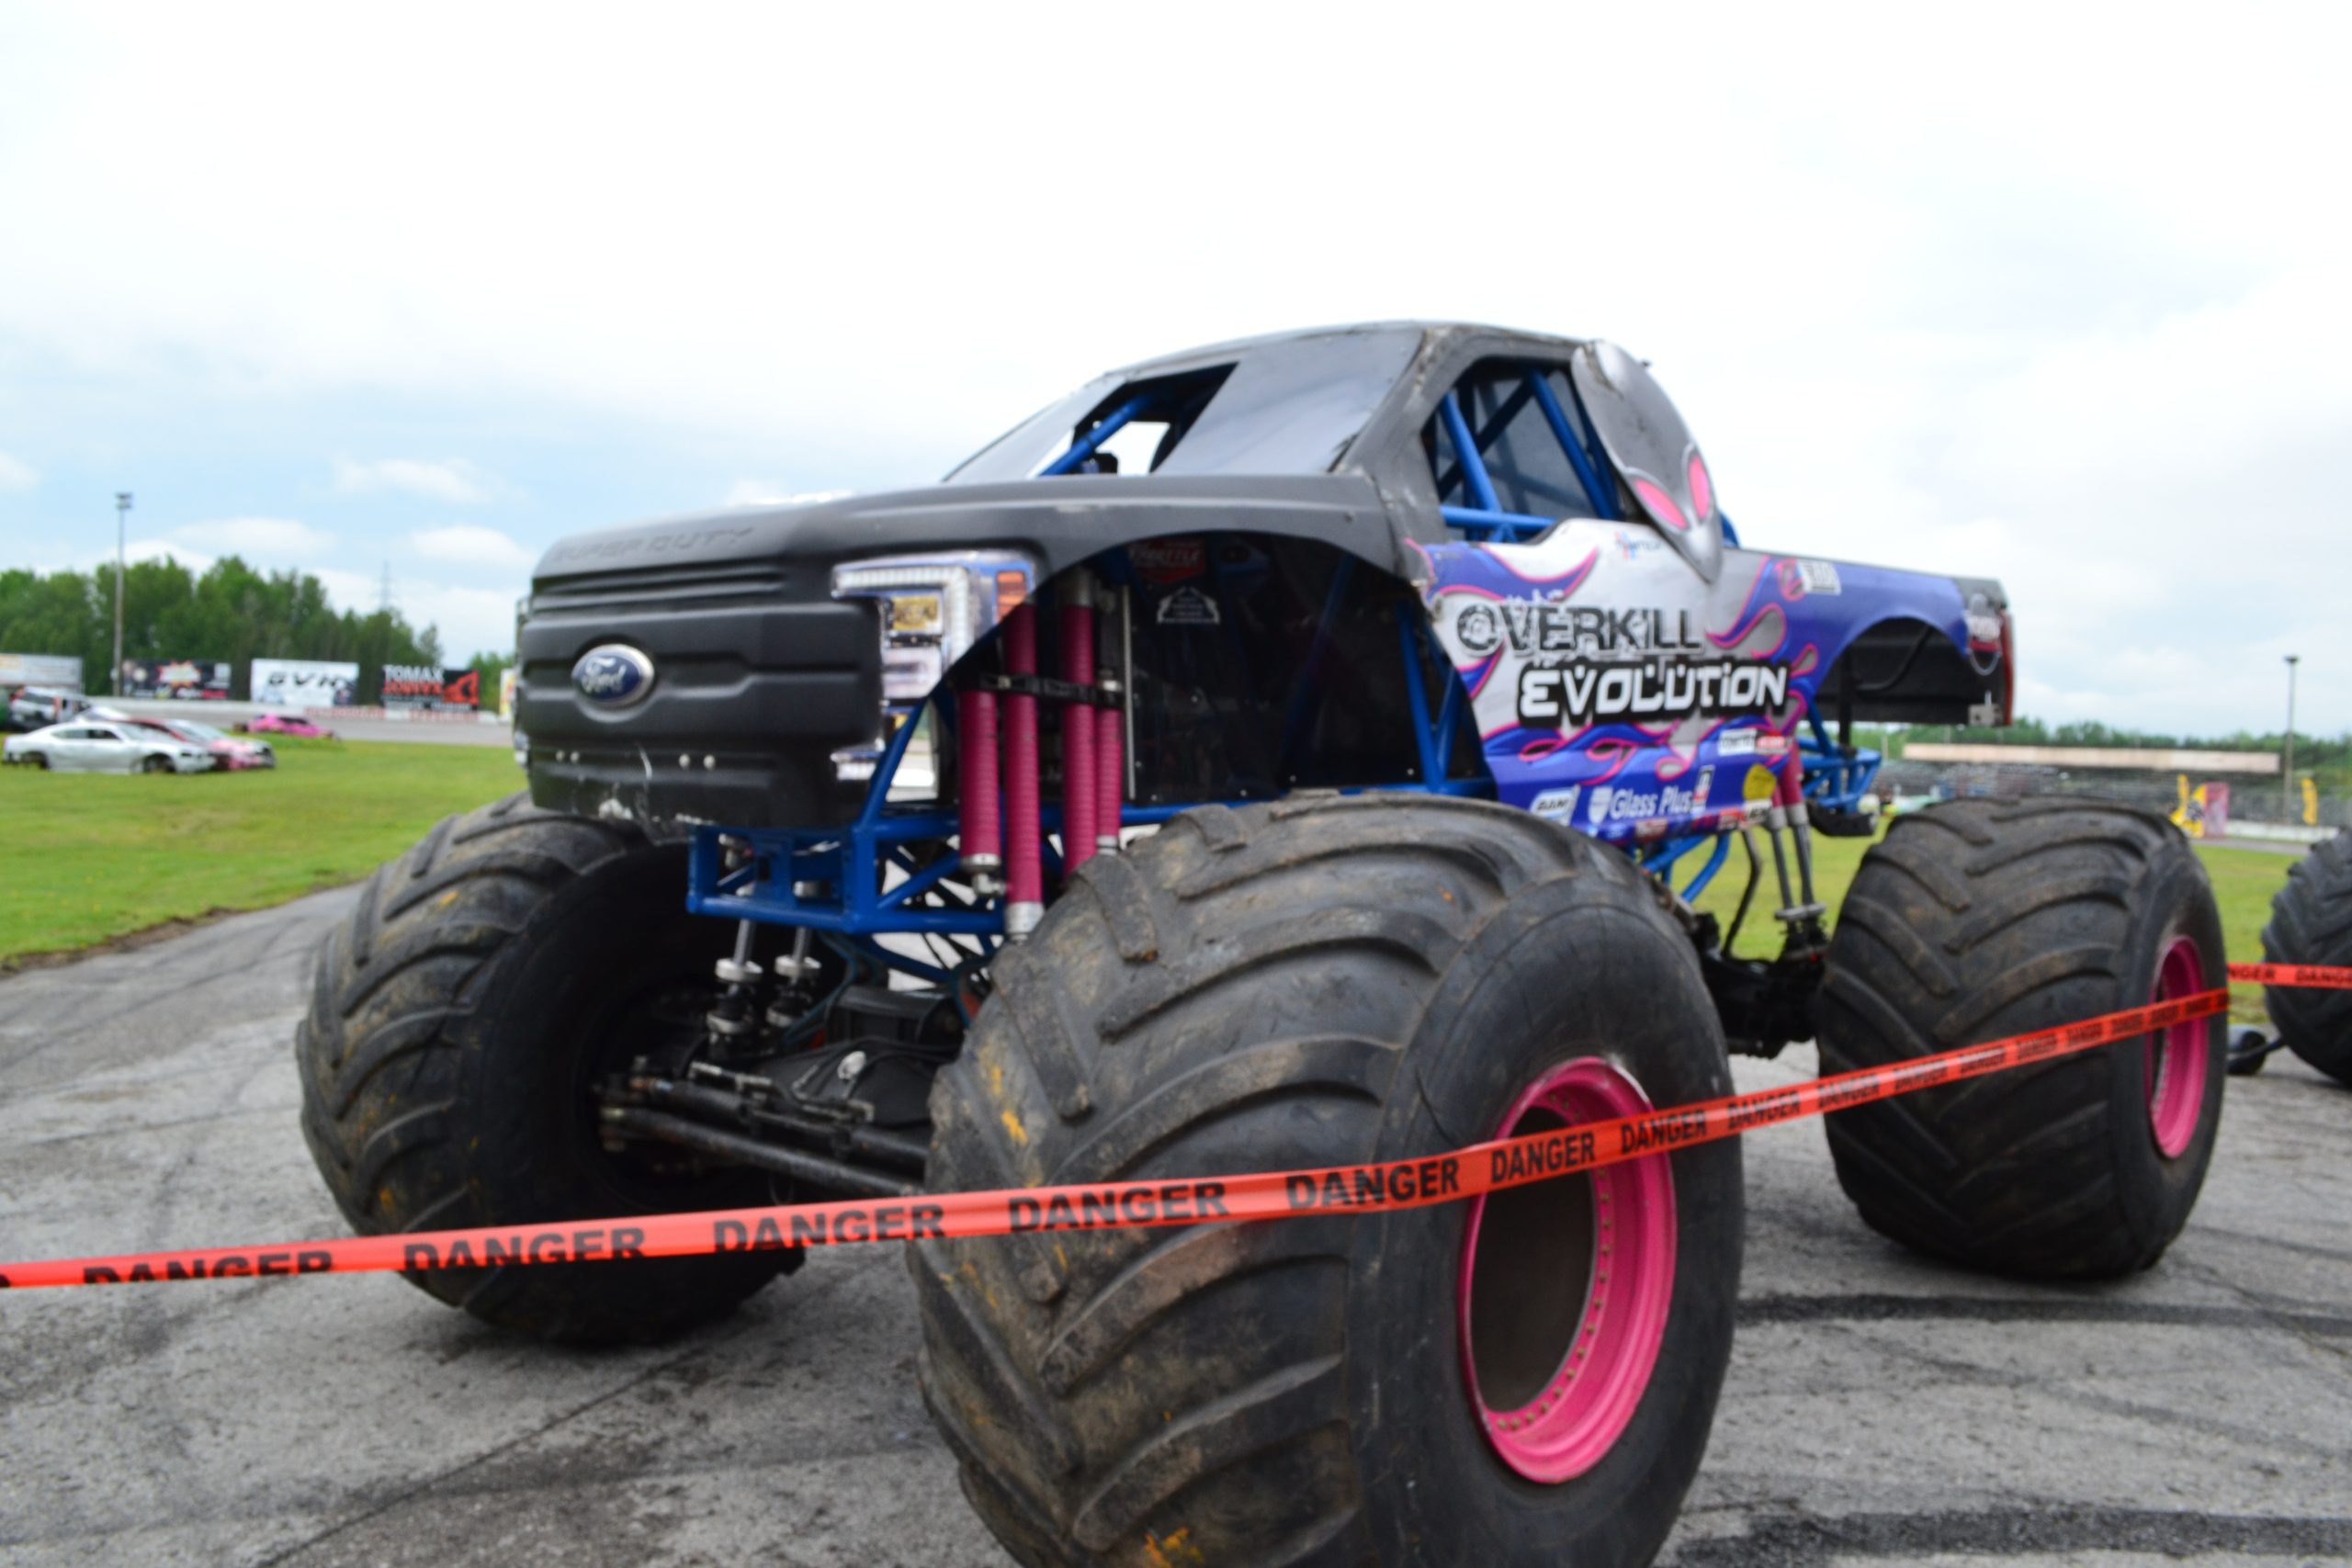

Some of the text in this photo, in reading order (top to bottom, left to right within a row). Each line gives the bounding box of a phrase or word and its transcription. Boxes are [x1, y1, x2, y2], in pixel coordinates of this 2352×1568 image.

[1456, 603, 1702, 656] OVERKILL
[581, 656, 628, 694] Ford
[1611, 785, 1693, 819] Glass Plus
[404, 1227, 645, 1271] DANGER
[713, 1203, 946, 1253] DANGER
[1007, 1181, 1229, 1233] DANGER
[1285, 1157, 1459, 1210] DANGER
[1490, 1131, 1596, 1184] DANGER
[1620, 1109, 1708, 1155] DANGER
